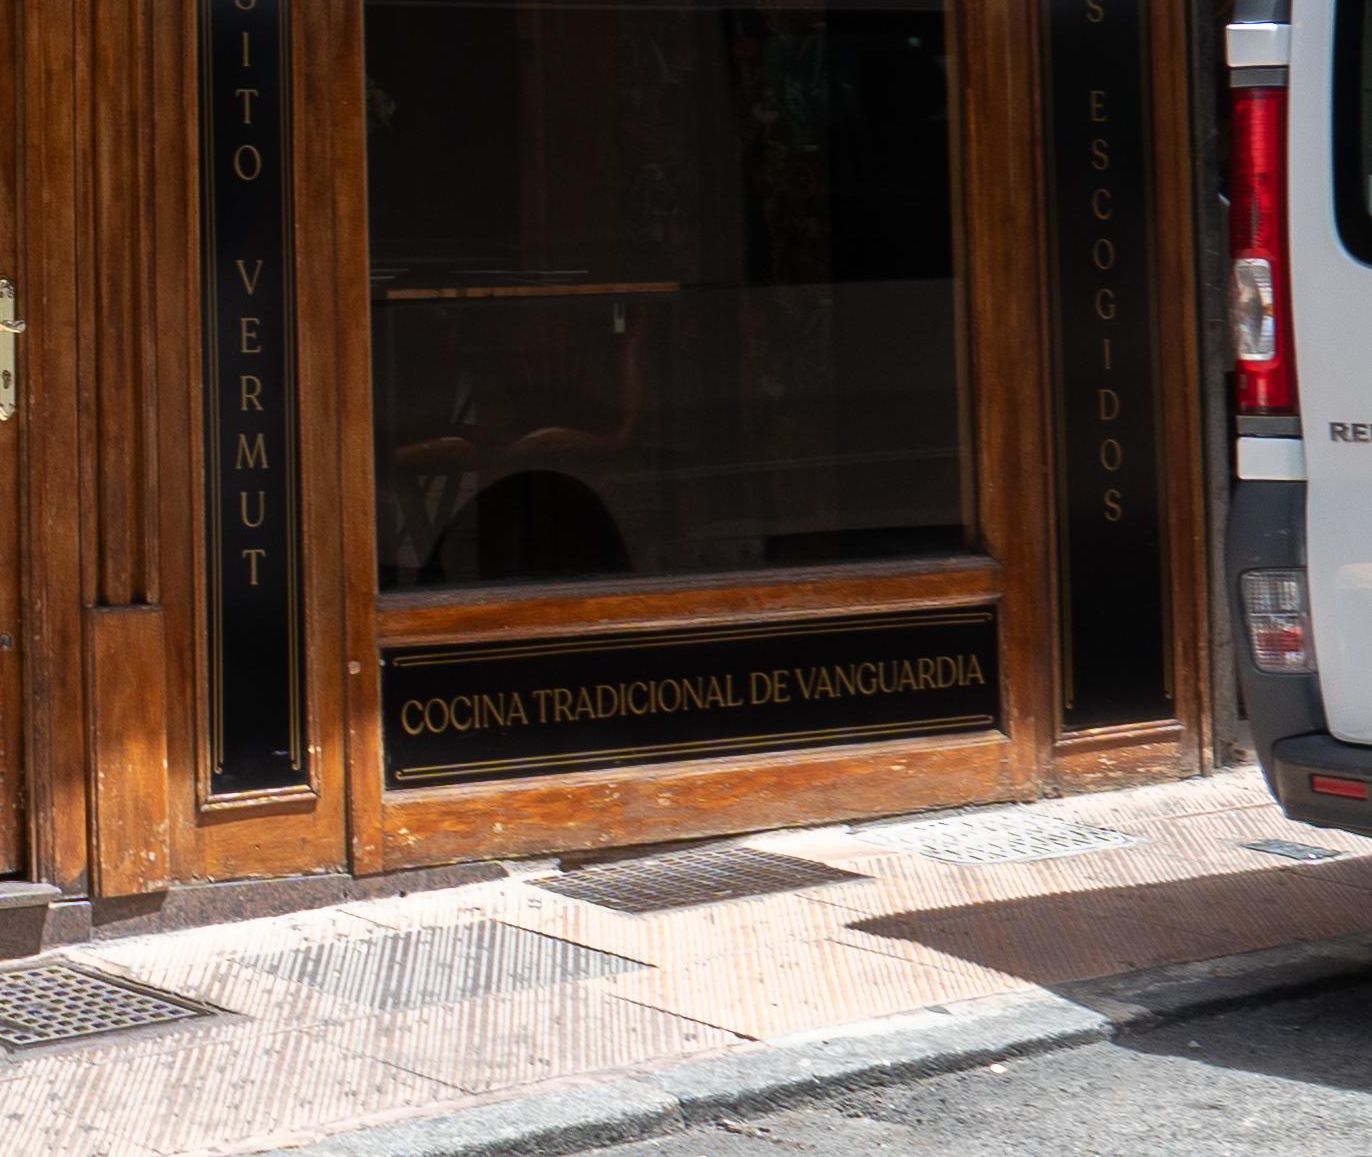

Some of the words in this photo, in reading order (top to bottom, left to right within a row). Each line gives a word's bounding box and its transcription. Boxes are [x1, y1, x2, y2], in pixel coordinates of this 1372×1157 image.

[1089, 90, 1123, 522] ESCOGIDOS
[236, 259, 269, 586] VERMUT
[1328, 422, 1372, 442] RE
[400, 691, 529, 736] COCINA
[531, 673, 744, 724] TRADICIONAL
[750, 669, 791, 705] DE
[794, 653, 986, 700] VANGUARDIA
